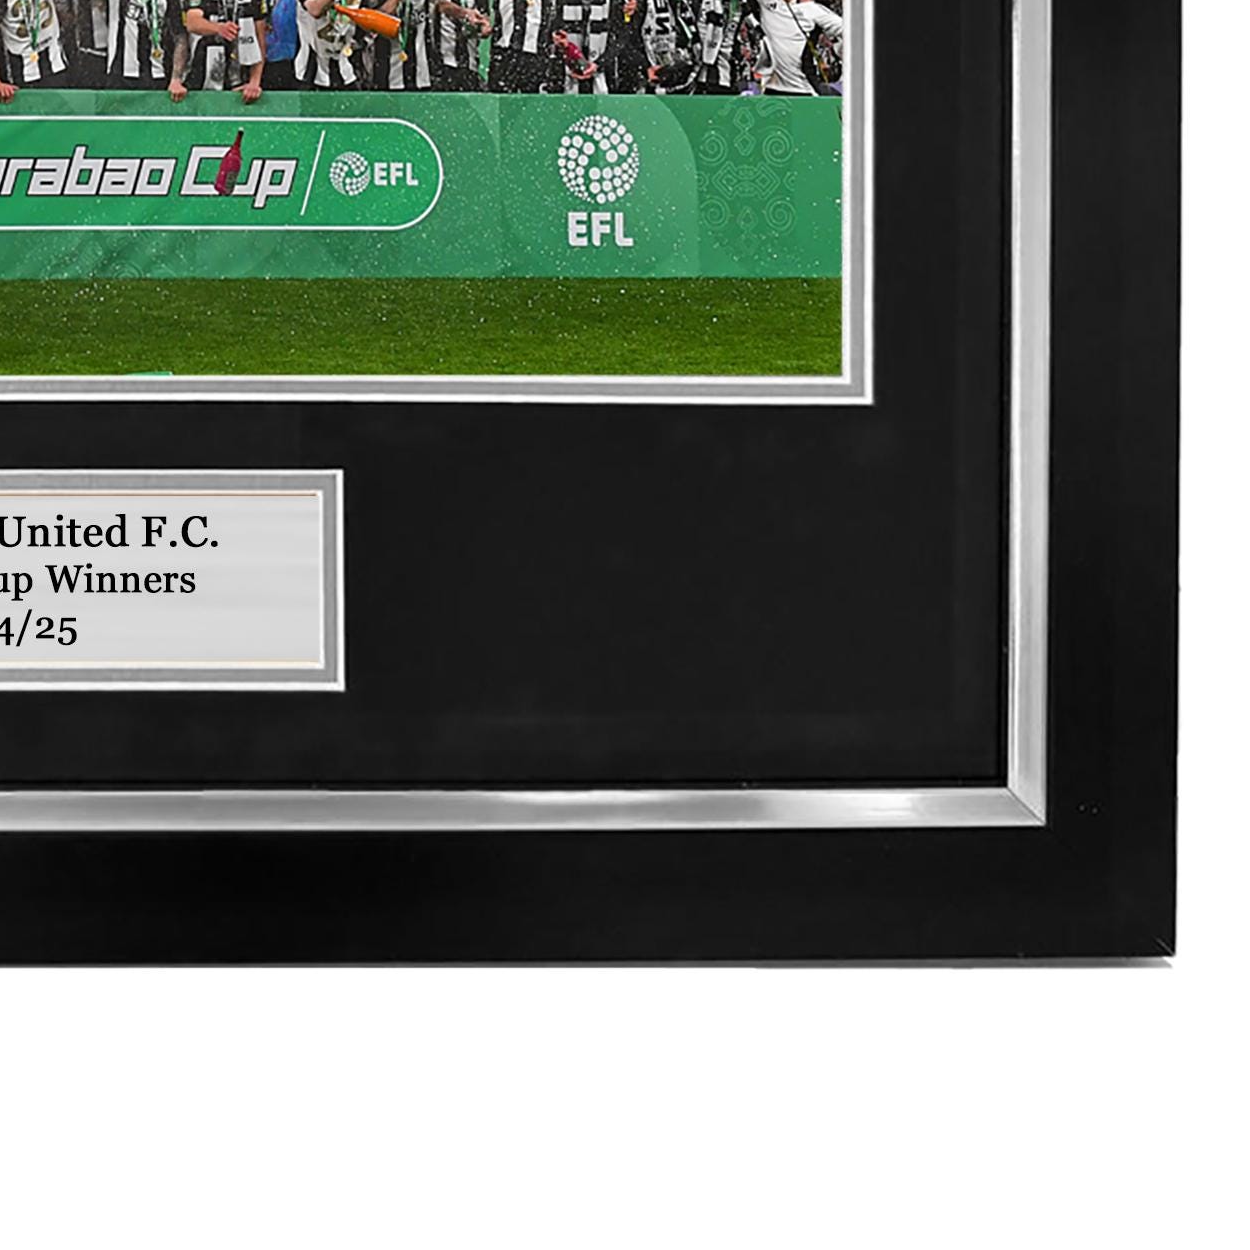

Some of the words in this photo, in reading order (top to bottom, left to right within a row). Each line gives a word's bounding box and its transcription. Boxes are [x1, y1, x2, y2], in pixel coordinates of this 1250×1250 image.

[180, 146, 297, 209] Cup
[373, 162, 419, 186] EFL
[567, 211, 634, 247] EFL
[141, 515, 220, 548] F.C.
[44, 562, 196, 594] Winners
